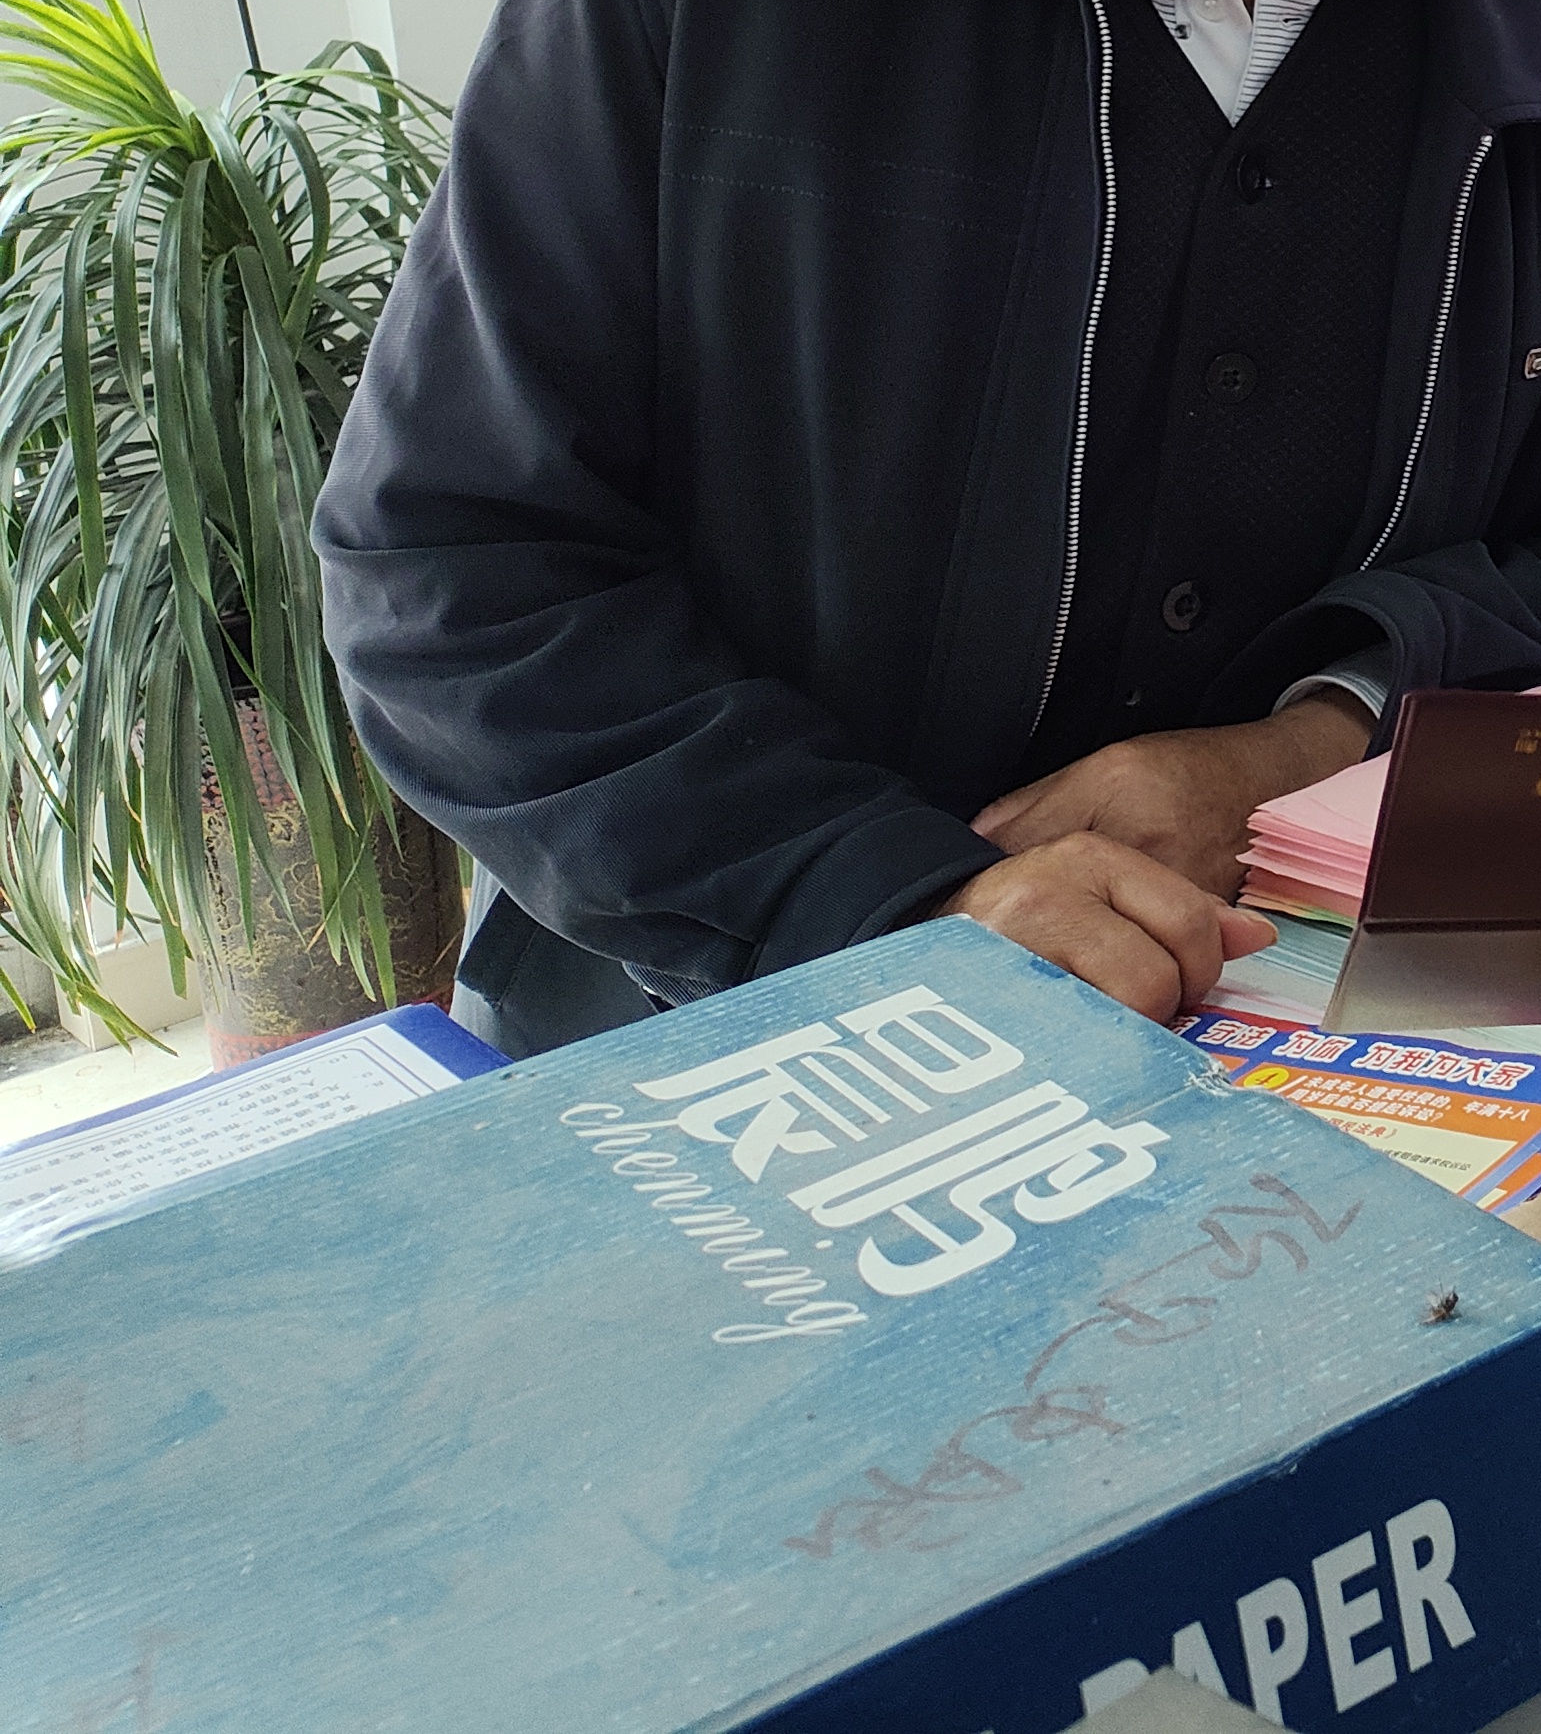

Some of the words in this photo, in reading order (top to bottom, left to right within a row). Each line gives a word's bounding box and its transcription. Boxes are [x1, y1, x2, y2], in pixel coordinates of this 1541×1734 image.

[1272, 1029, 1357, 1064] 为你
[1351, 1041, 1536, 1093] 为我为大家
